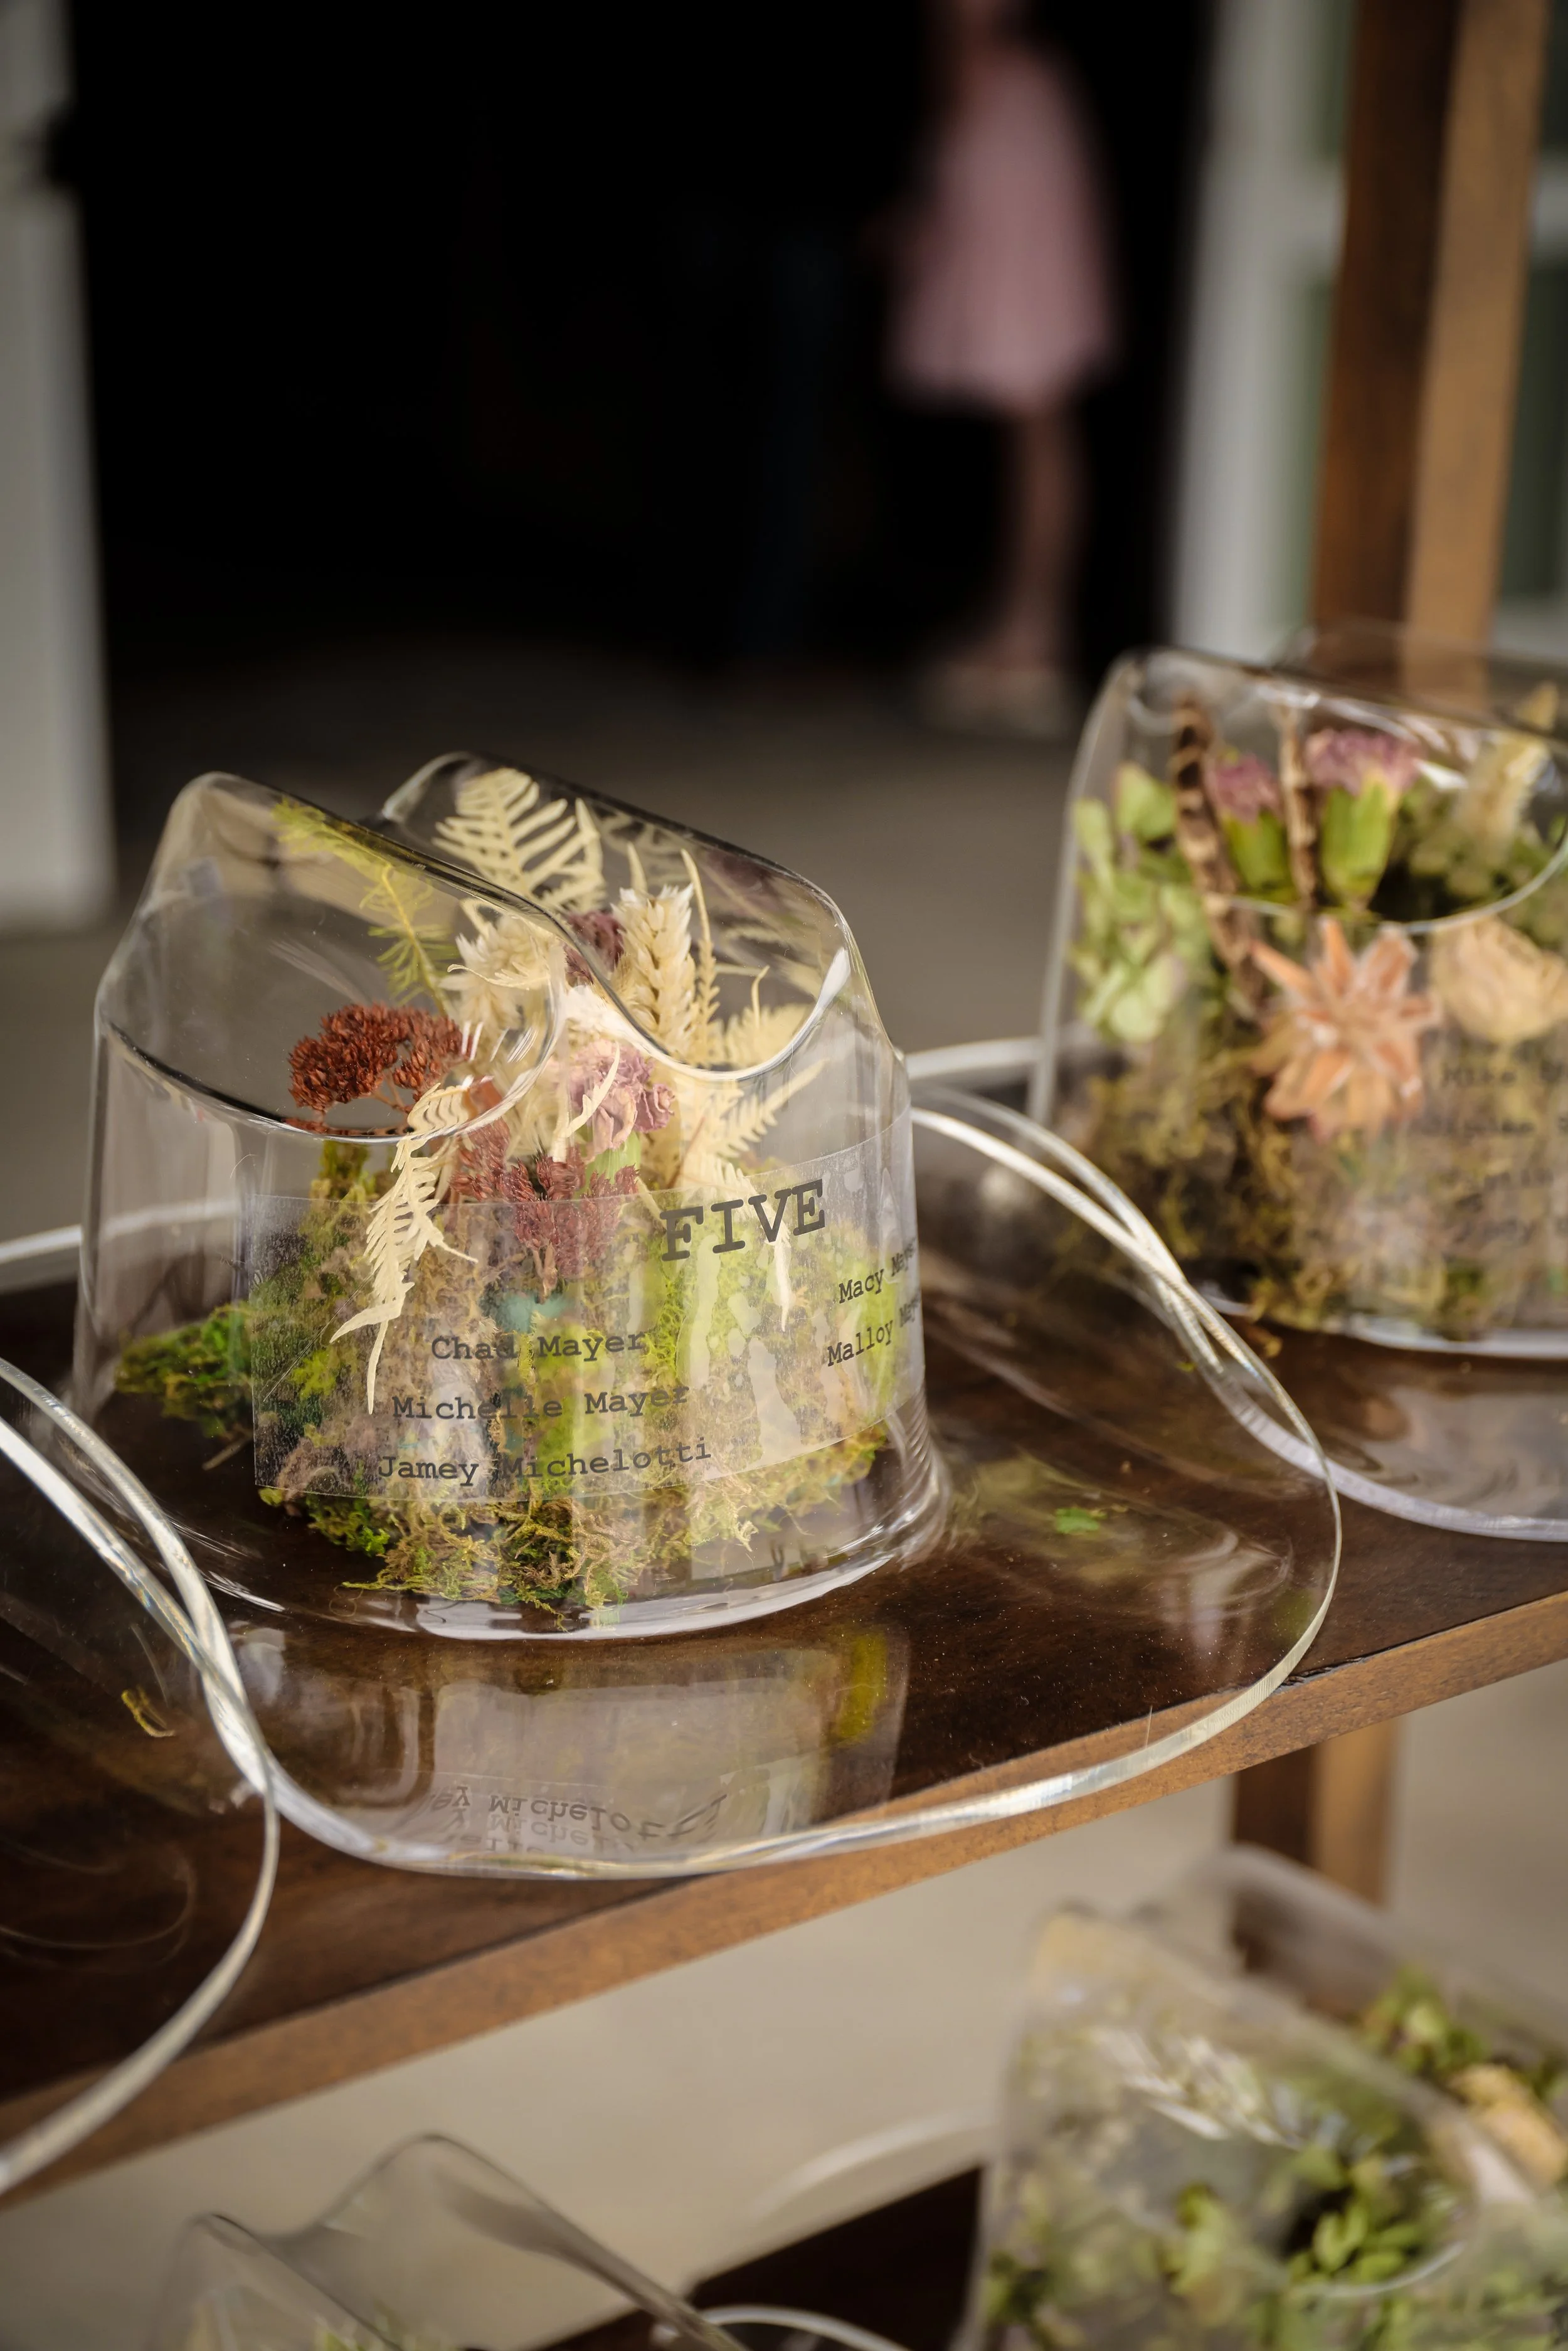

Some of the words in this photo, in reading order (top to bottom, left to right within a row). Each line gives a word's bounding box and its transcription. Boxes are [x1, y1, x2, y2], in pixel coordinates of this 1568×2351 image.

[660, 1179, 825, 1261] FIVE
[839, 1269, 884, 1304] Macy
[432, 1335, 515, 1360] Chad
[538, 1330, 647, 1362] Mayer
[827, 1320, 894, 1367] Malloy
[393, 1394, 562, 1420] Michelle
[585, 1385, 689, 1416] Mayer
[378, 1456, 479, 1486] Jamey
[504, 1437, 712, 1478] Michelotti
